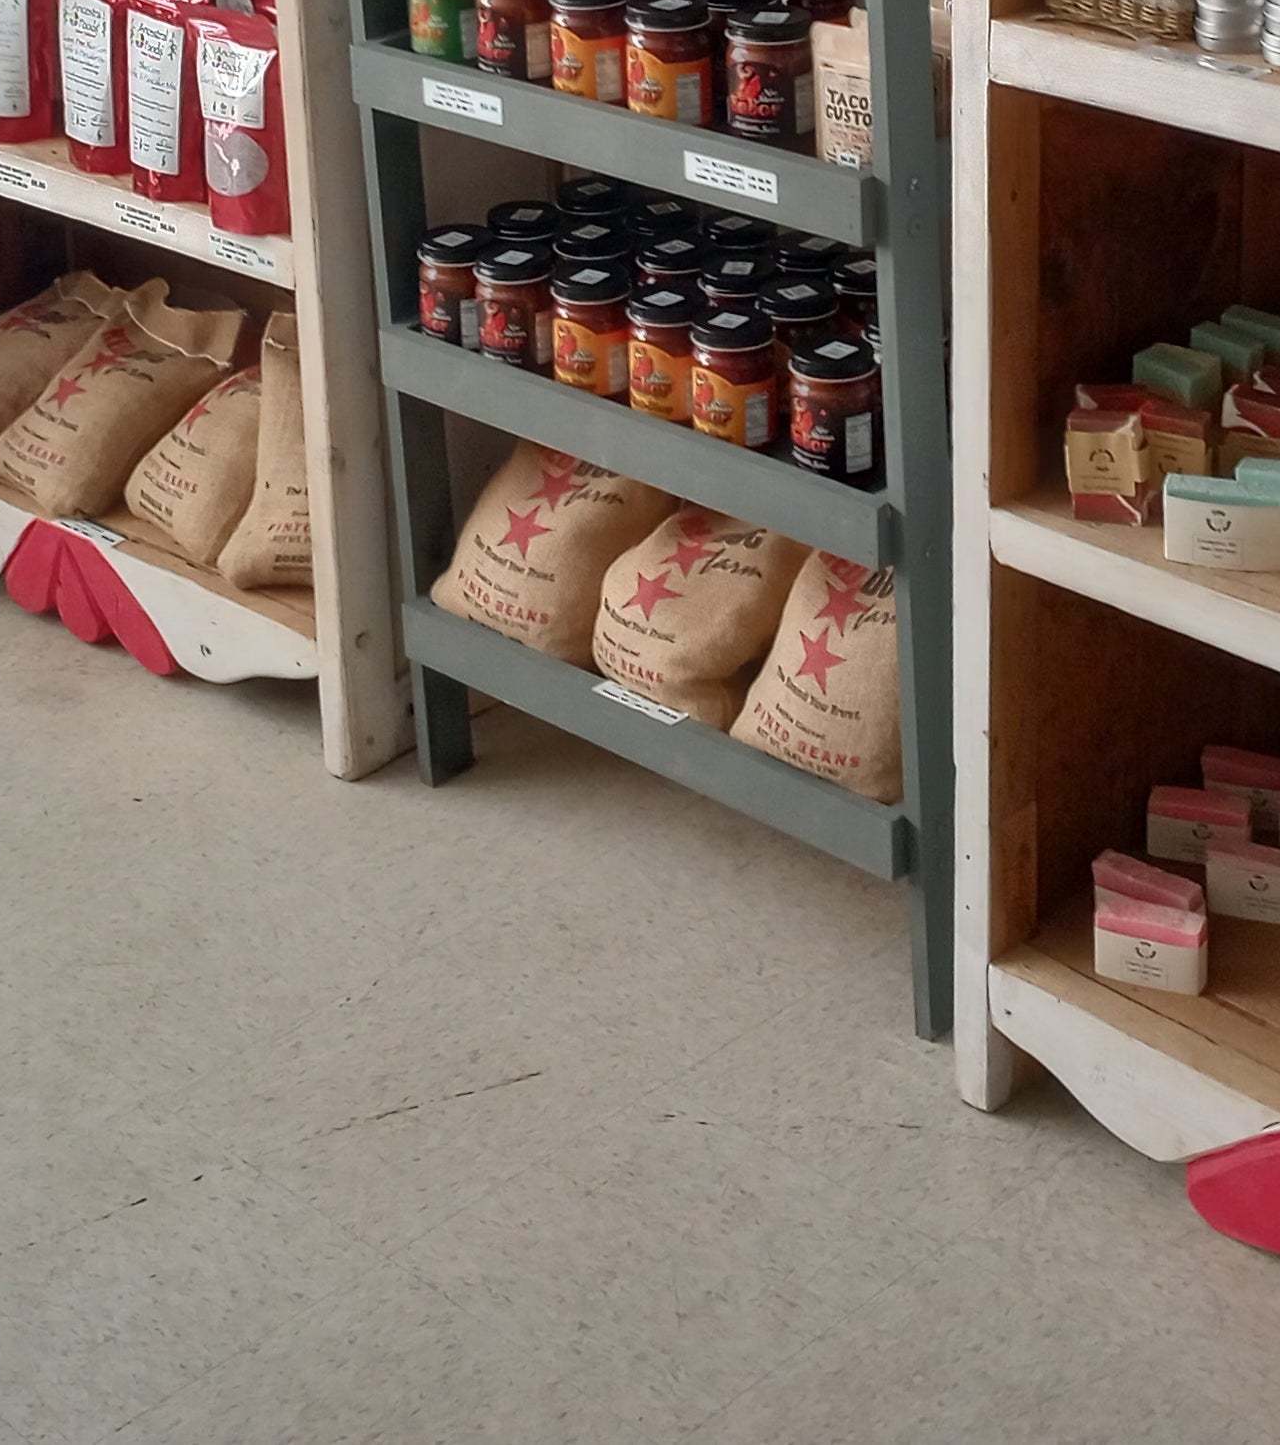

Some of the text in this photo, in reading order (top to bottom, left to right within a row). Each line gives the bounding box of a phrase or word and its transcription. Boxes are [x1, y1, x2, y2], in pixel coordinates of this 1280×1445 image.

[826, 88, 869, 110] TACO
[826, 105, 873, 128] GUSTO
[164, 471, 199, 494] BEANS
[698, 547, 762, 579] farm
[458, 569, 550, 626] PINTO BEANS
[621, 660, 664, 684] BEANS
[830, 703, 861, 721] Trust
[753, 702, 860, 769] PINTO BEANS
